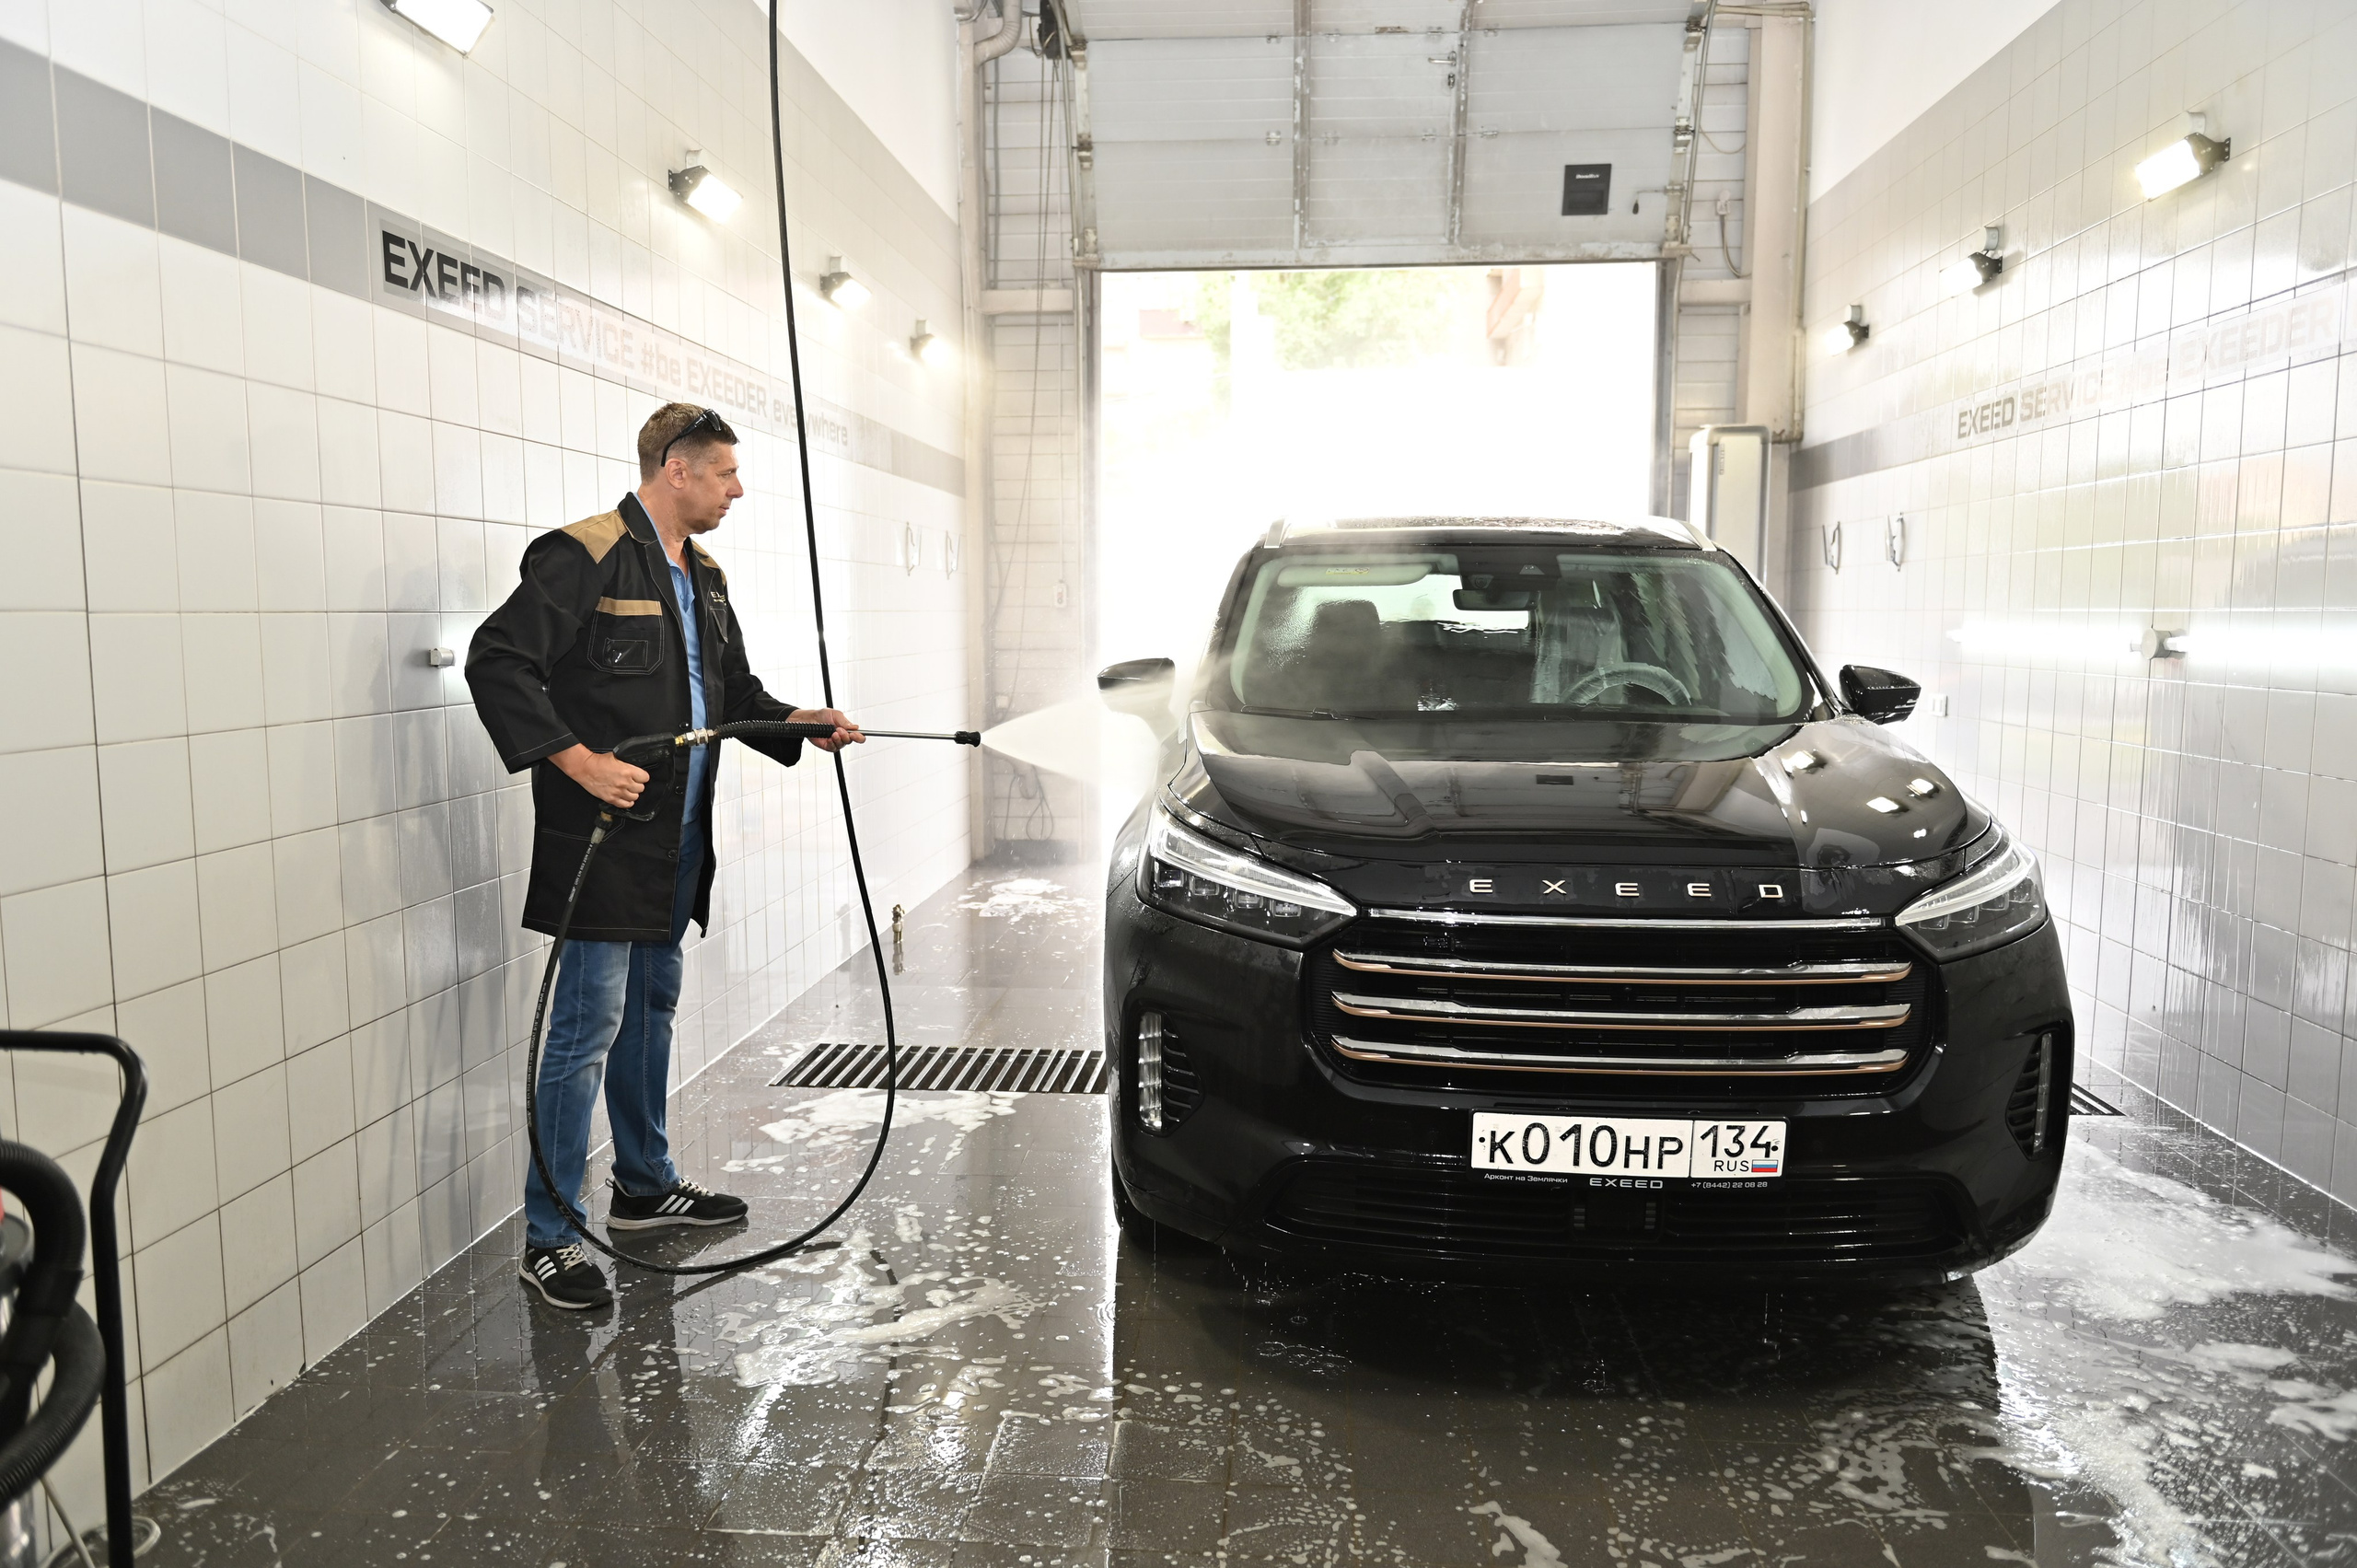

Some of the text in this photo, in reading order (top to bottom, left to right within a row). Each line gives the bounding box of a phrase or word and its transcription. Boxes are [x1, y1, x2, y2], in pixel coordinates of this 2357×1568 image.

[382, 229, 848, 447] EXEED SERVICE #be EXEEDER eveywhere
[1957, 396, 2015, 440] EXEED
[2020, 366, 2114, 423] SERVICE
[2178, 296, 2335, 379] EXEEDER
[1469, 878, 1783, 899] EXEED
[1700, 1125, 1771, 1158] 134
[1713, 1160, 1749, 1172] RUS
[1527, 1175, 1568, 1183] Землячки
[1589, 1178, 1664, 1189] EXEED
